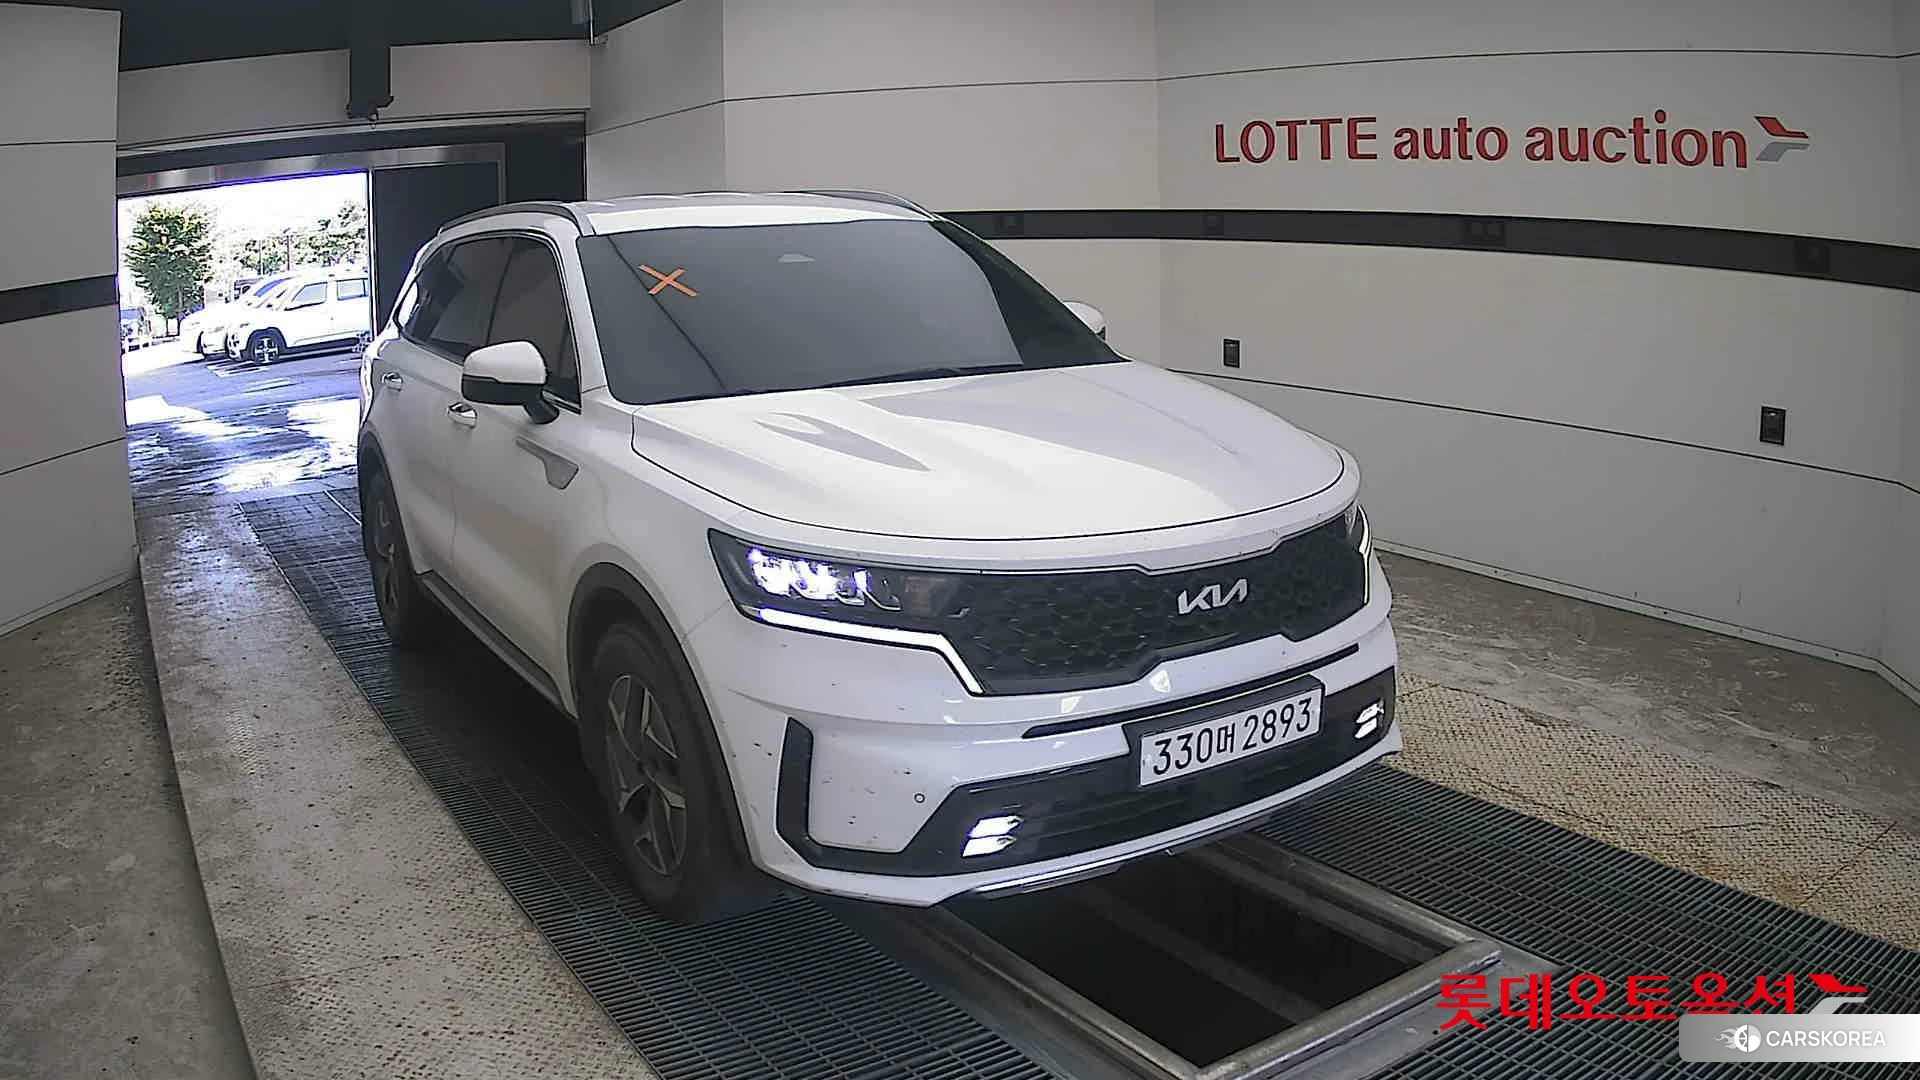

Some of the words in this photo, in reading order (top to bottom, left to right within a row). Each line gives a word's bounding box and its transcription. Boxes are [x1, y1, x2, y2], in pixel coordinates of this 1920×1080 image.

[1214, 116, 1378, 163] LOTTE
[1393, 116, 1509, 161] auto
[1524, 109, 1749, 168] auction
[1176, 577, 1249, 615] KIA
